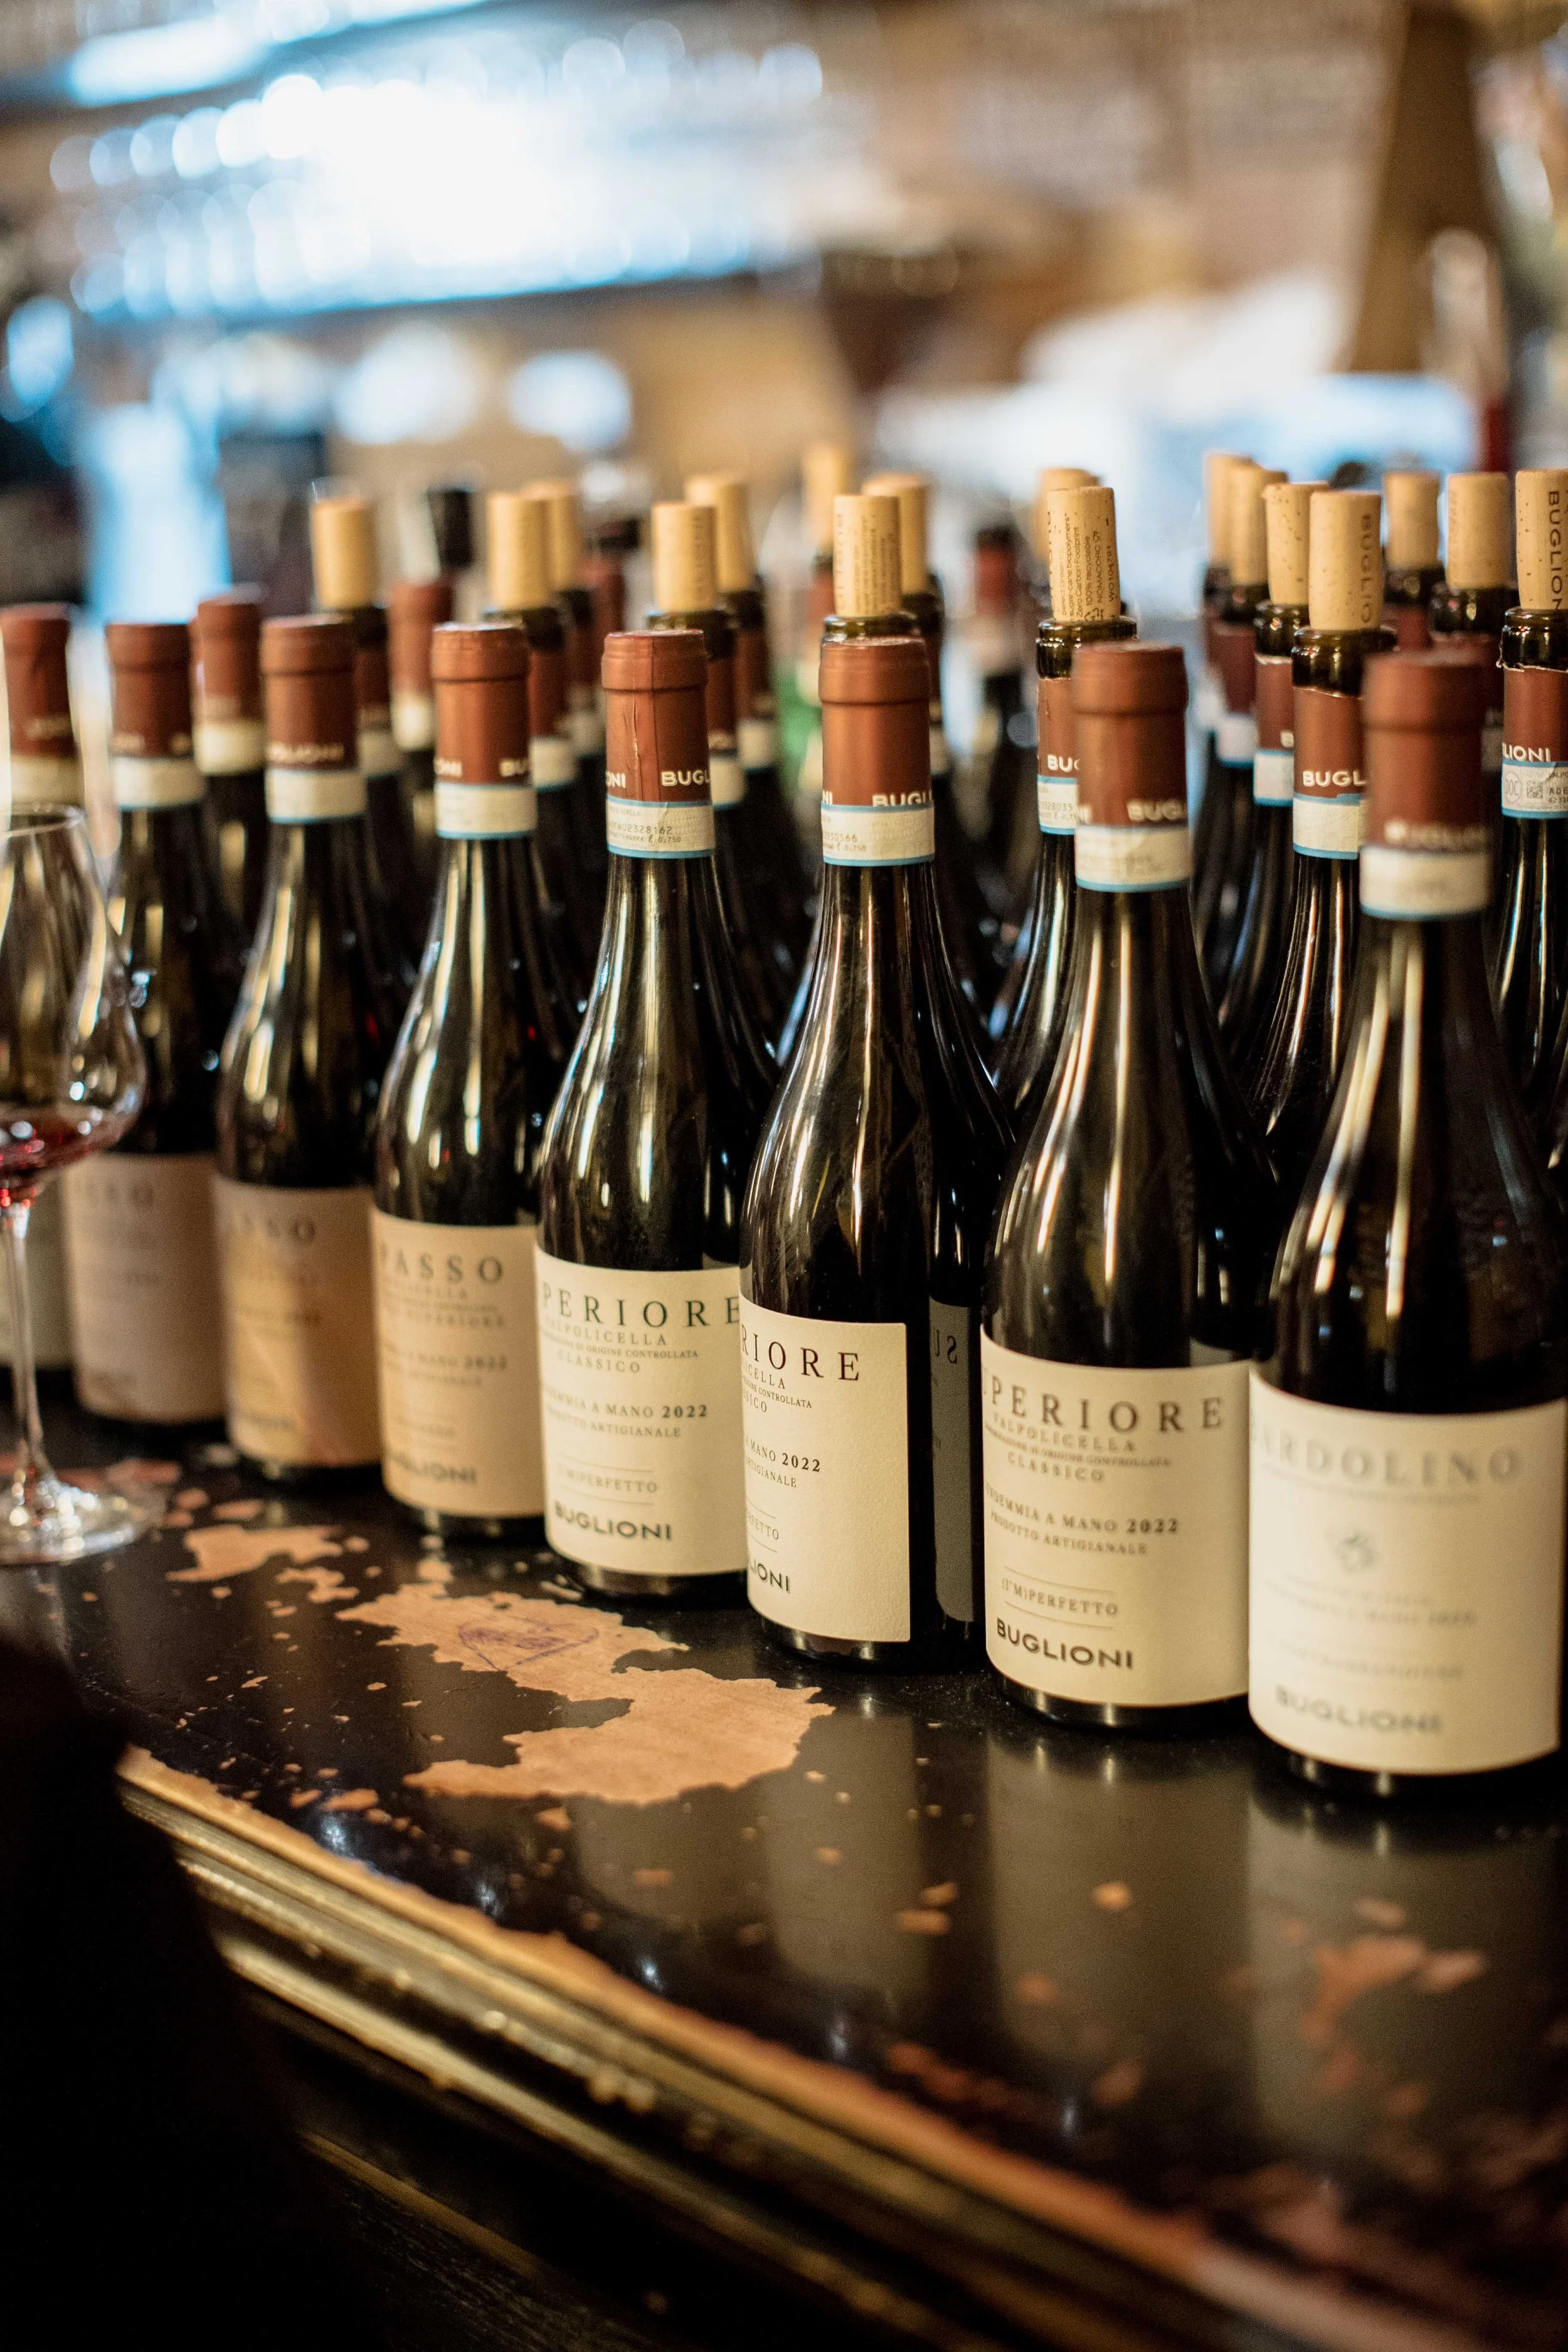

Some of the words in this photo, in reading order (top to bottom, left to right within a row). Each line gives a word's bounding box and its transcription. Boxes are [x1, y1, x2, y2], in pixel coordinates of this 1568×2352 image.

[1073, 526, 1081, 564] Footprint
[1083, 536, 1093, 577] recyclable
[1094, 544, 1103, 603] NOMACORC
[1075, 598, 1083, 618] Zero
[1084, 583, 1093, 606] 100%
[1303, 770, 1367, 787] BUGL
[626, 1349, 699, 1359] CONTROLLATA
[741, 1324, 860, 1381] RIORE
[606, 1403, 654, 1419] MANO
[662, 1404, 708, 1419] 2022
[758, 1387, 812, 1409] CONTROLLATA
[591, 1420, 682, 1438] ARTIGIANALE
[993, 1411, 1136, 1453] VALPOLICELLA
[750, 1438, 776, 1462] MANO
[781, 1452, 821, 1473] 2022
[1007, 1451, 1106, 1483] CLASSICO
[554, 1500, 672, 1541] BUGLIONI
[1045, 1512, 1056, 1525] A
[1062, 1513, 1118, 1534] MANO
[1126, 1518, 1178, 1535] 2022
[1043, 1534, 1148, 1555] ARTIGIANALE
[997, 1617, 1133, 1670] BUGLIONI
